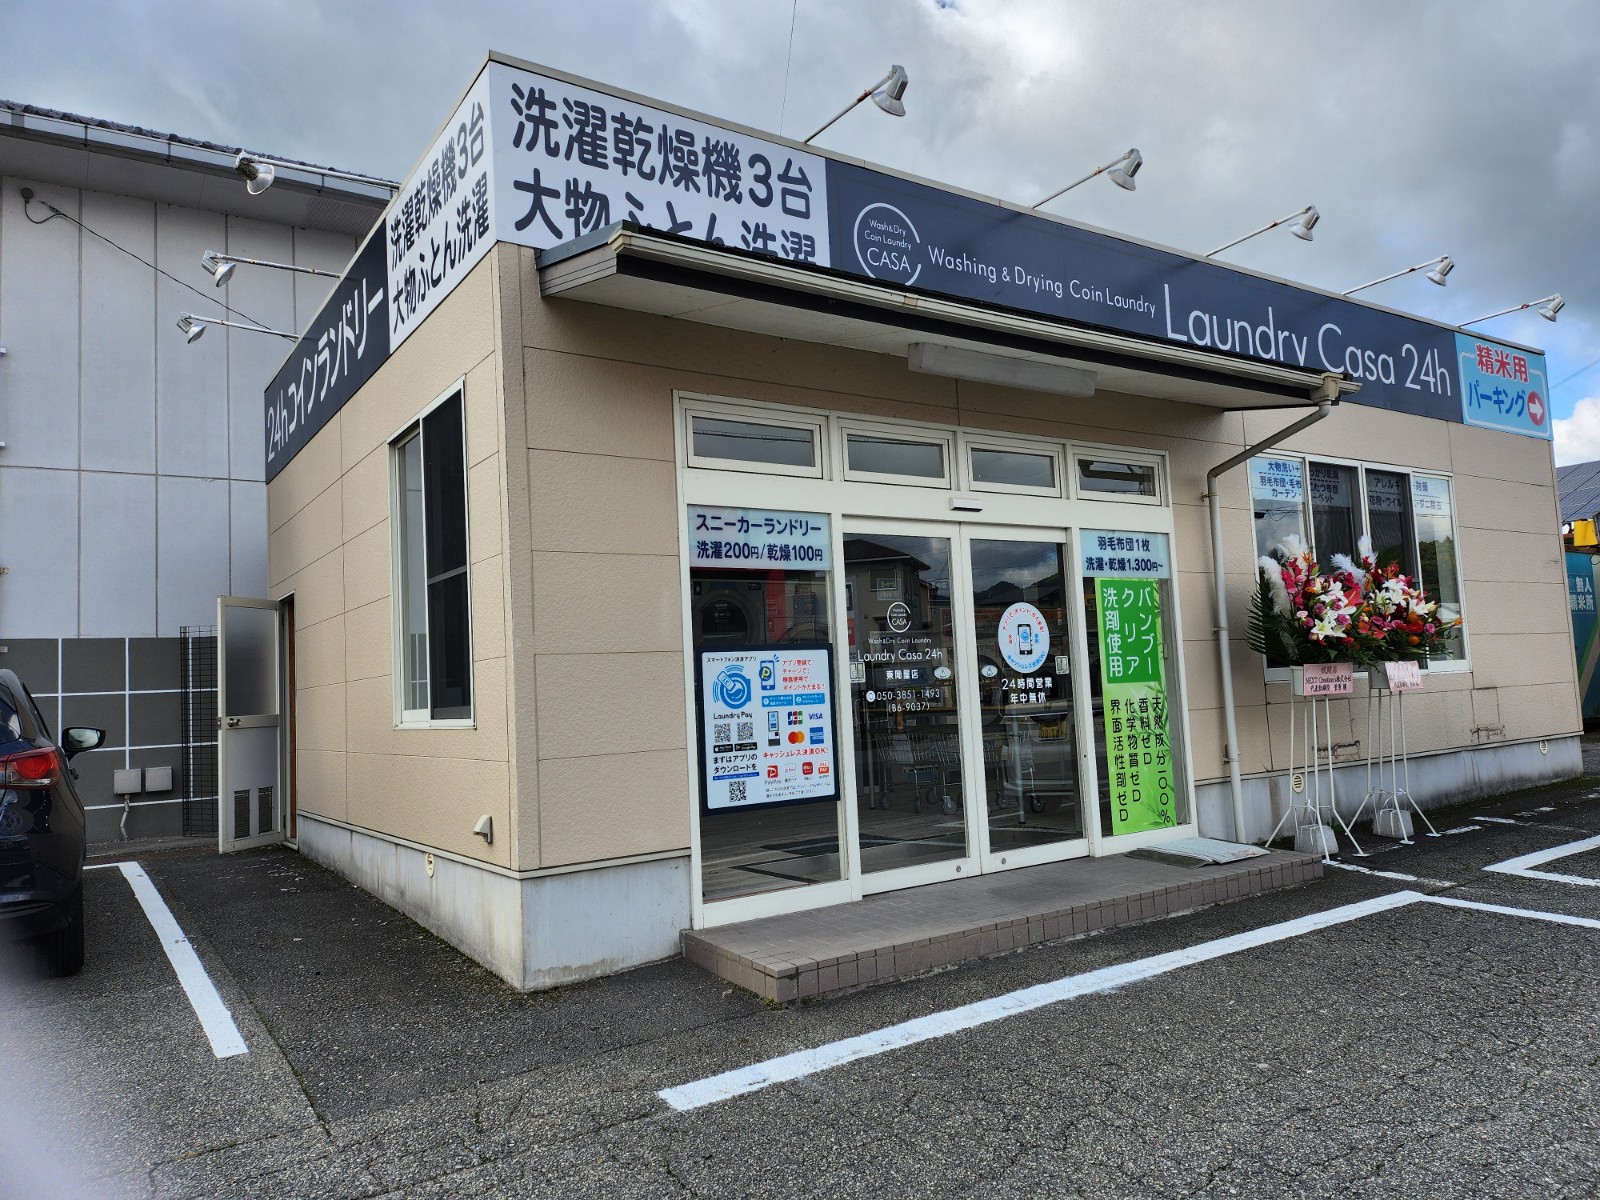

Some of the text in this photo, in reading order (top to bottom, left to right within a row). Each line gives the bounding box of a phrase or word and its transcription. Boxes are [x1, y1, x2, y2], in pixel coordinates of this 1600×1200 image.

[511, 83, 812, 220] 洗濯乾燥機3台
[390, 101, 484, 270] 洗濯乾燥機3台
[392, 171, 489, 335] 大物ふとん洗濯
[864, 229, 911, 251] Coin Laundry
[867, 247, 911, 273] CASA
[928, 245, 1156, 319] Washing & Drying Coin Laundry
[1164, 283, 1451, 397] Laundry Casa 24h
[266, 277, 383, 464] 24hコインランドリー
[1475, 343, 1528, 383] 精米用
[1468, 379, 1525, 418] パーキング
[696, 514, 822, 536] スニーカーランドリー
[696, 541, 823, 561] 洗濯200円/乾燥100円
[1097, 536, 1151, 552] 羽毛布団1枚
[891, 618, 907, 626] CASA
[1103, 587, 1123, 678] 洗剤使用
[1121, 588, 1140, 675] クリア
[1138, 587, 1154, 675] バンブー
[897, 637, 910, 645] Coin
[857, 648, 943, 663] Laundry Casa 24h
[876, 689, 940, 701] 050-3851-1493
[1001, 677, 1053, 690] 24時間営業
[1010, 692, 1047, 704] 年中無休
[713, 711, 753, 720] Laundry Pay
[713, 753, 758, 764] まずはアプリの
[1109, 699, 1130, 822] 界面活性剤ゼロ
[1124, 698, 1142, 803] 化学物質ゼロ
[713, 763, 757, 775] ダウンロードを
